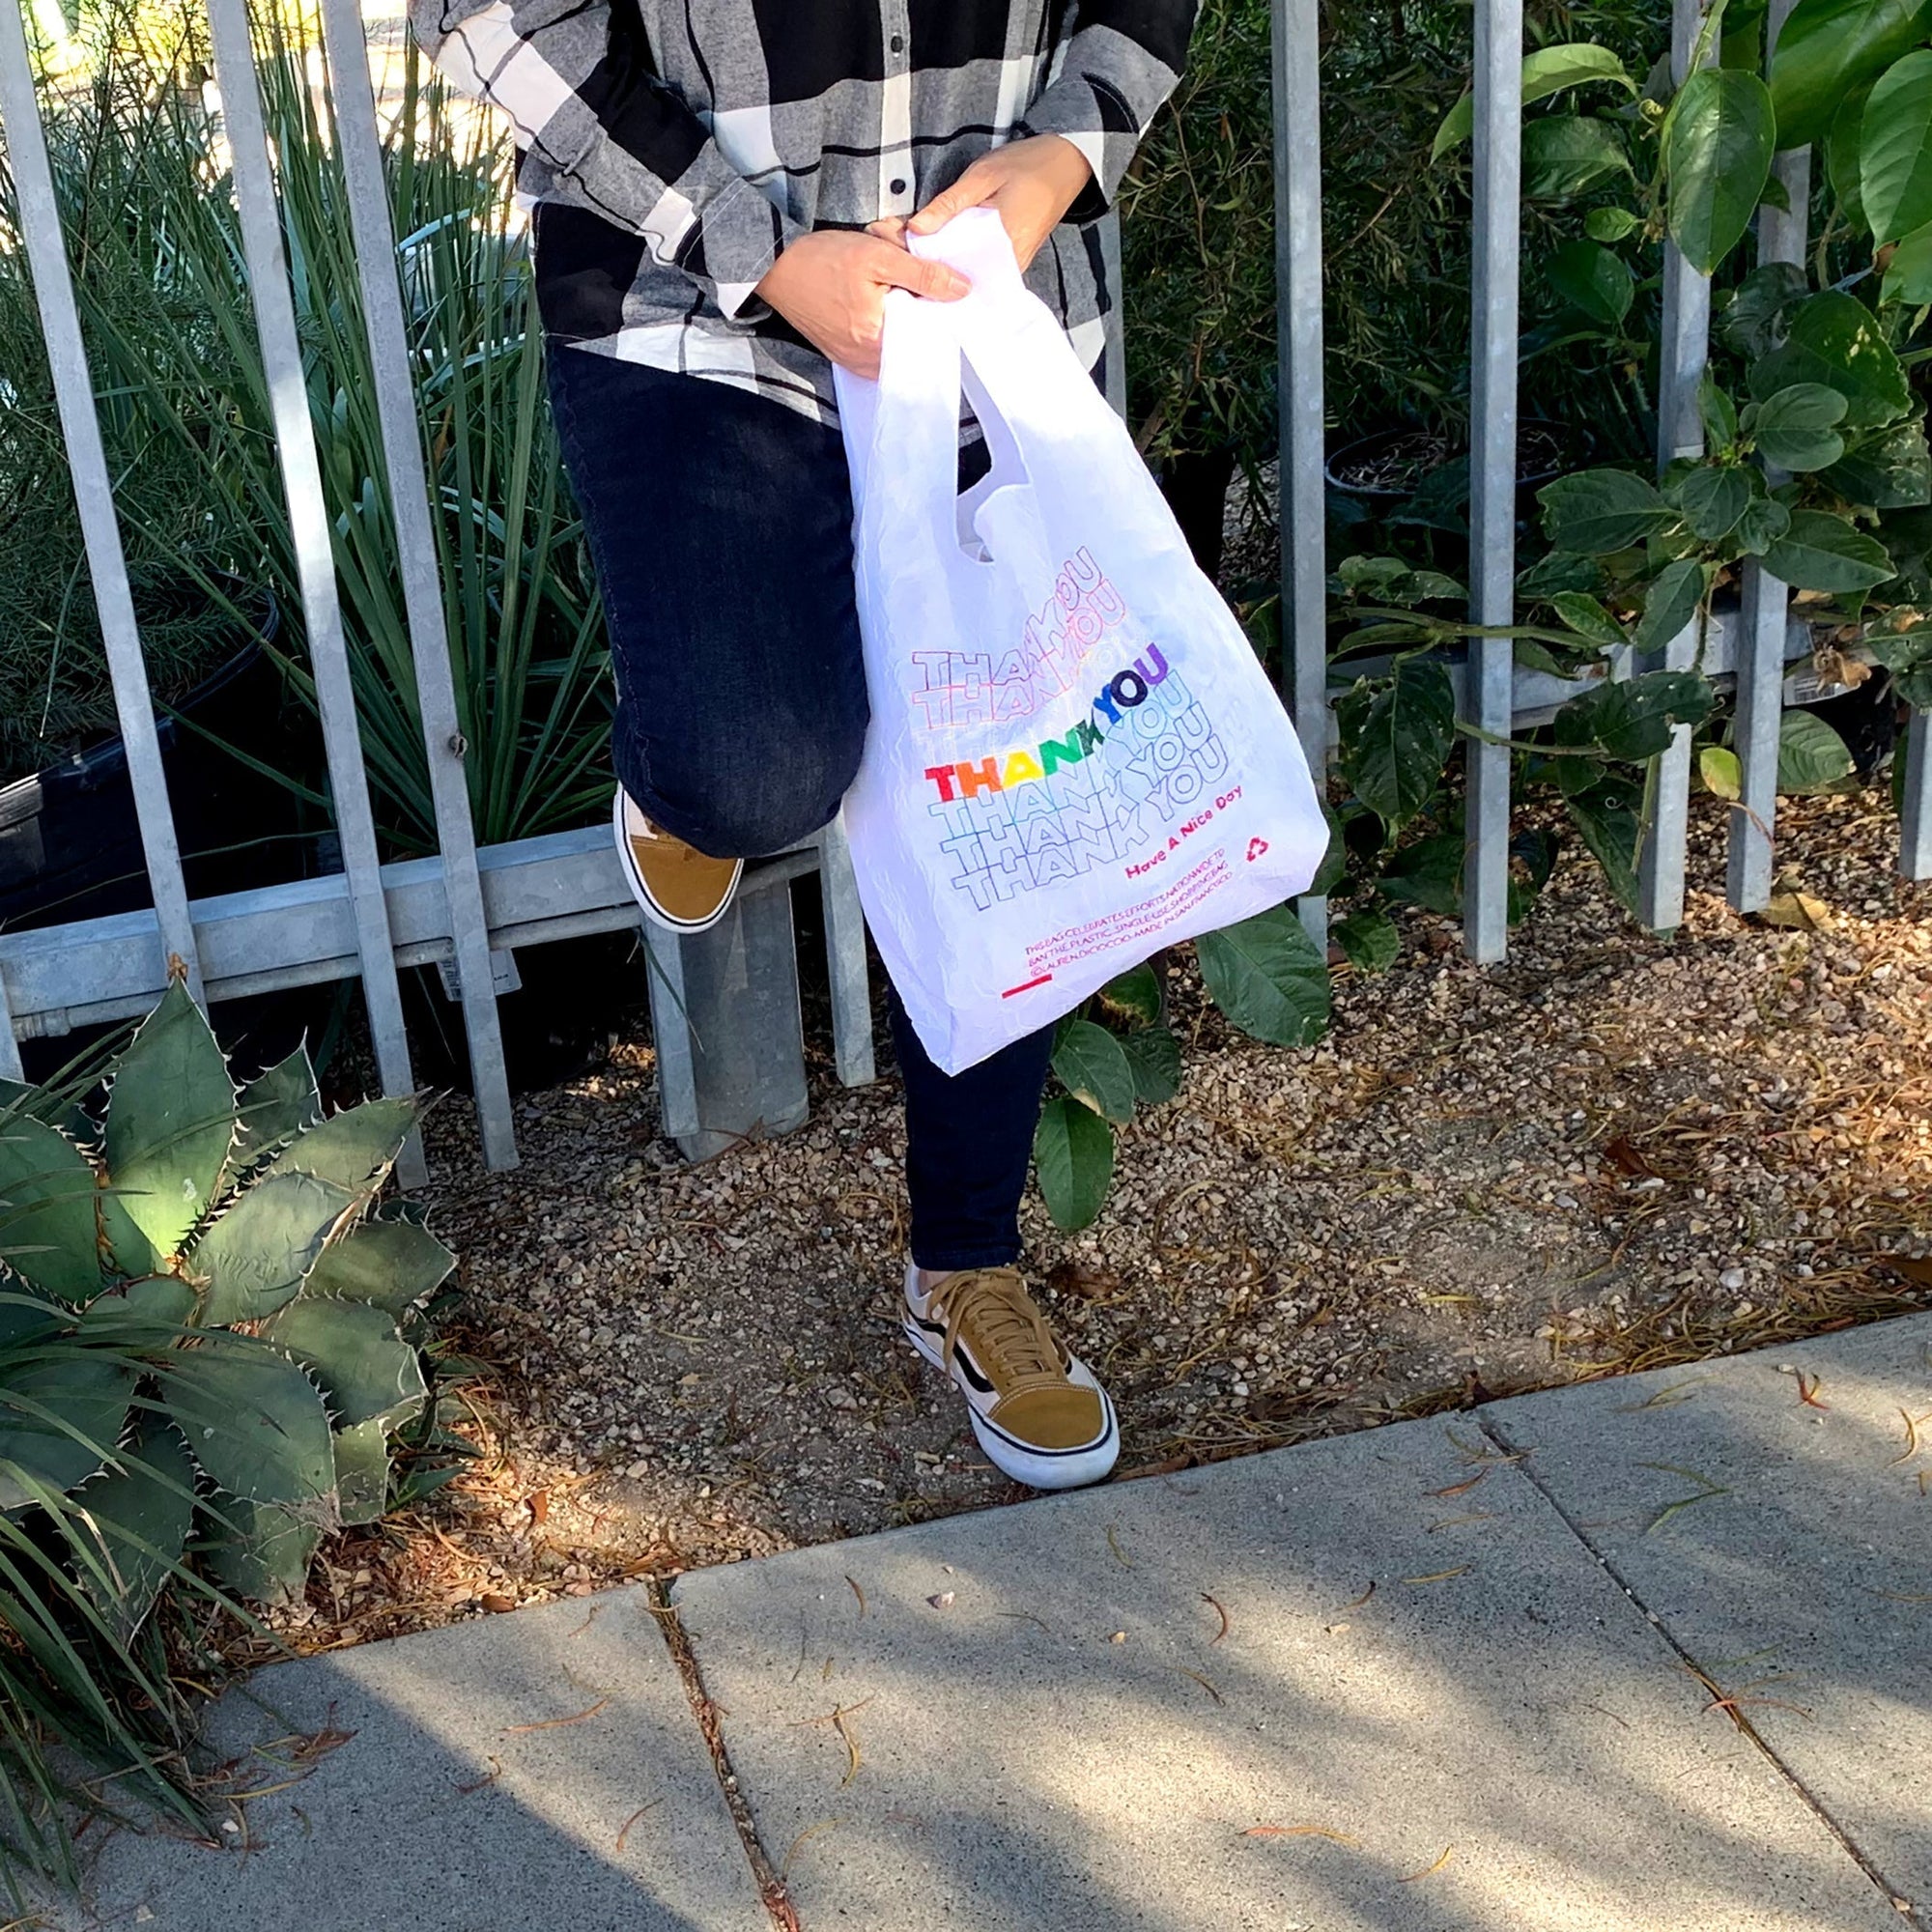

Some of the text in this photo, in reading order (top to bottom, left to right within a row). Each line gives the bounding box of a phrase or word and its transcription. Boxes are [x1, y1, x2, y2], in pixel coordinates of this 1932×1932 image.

[1055, 545, 1103, 612] OU
[924, 708, 1105, 802] THANK
[1093, 641, 1169, 725] YOU
[927, 738, 1121, 840] THANK
[1106, 668, 1193, 757] YOU
[940, 770, 1140, 875] THANK
[1125, 699, 1213, 789] YOU
[952, 804, 1151, 912] THANK
[1145, 732, 1230, 823] YOU
[1124, 785, 1241, 879] Have A Nice Day
